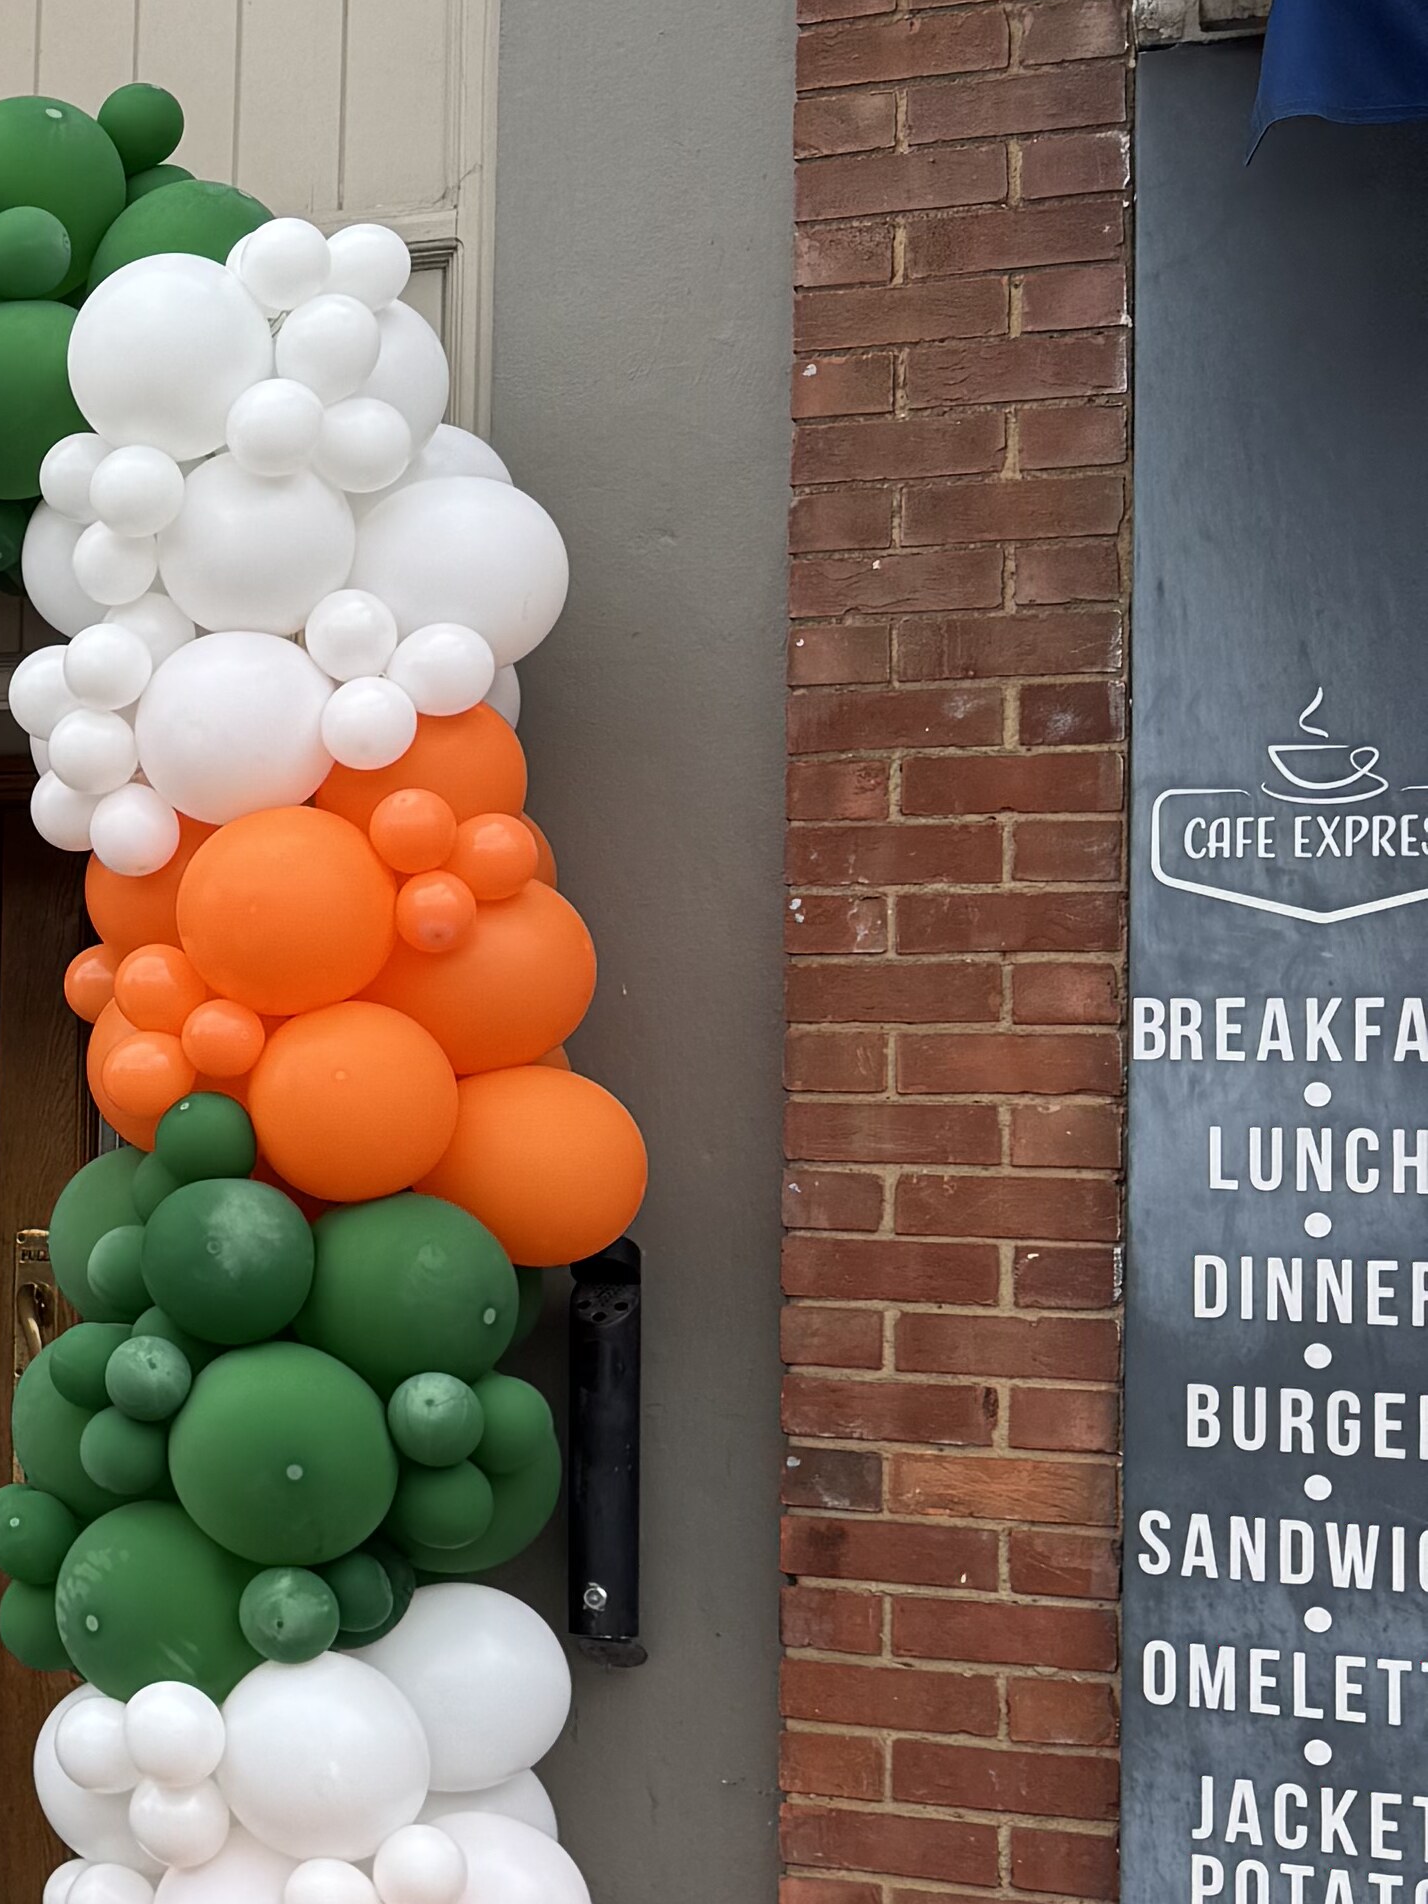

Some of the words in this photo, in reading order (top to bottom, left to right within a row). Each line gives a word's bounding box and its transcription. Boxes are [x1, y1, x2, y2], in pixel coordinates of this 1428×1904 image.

[1184, 816, 1276, 859] CAFE
[1294, 814, 1428, 859] EXPRE
[1209, 1126, 1428, 1195] LUNCH
[1186, 1383, 1428, 1461] BURGE
[1138, 1509, 1428, 1593] SANDWI
[1143, 1639, 1428, 1726] OMELET
